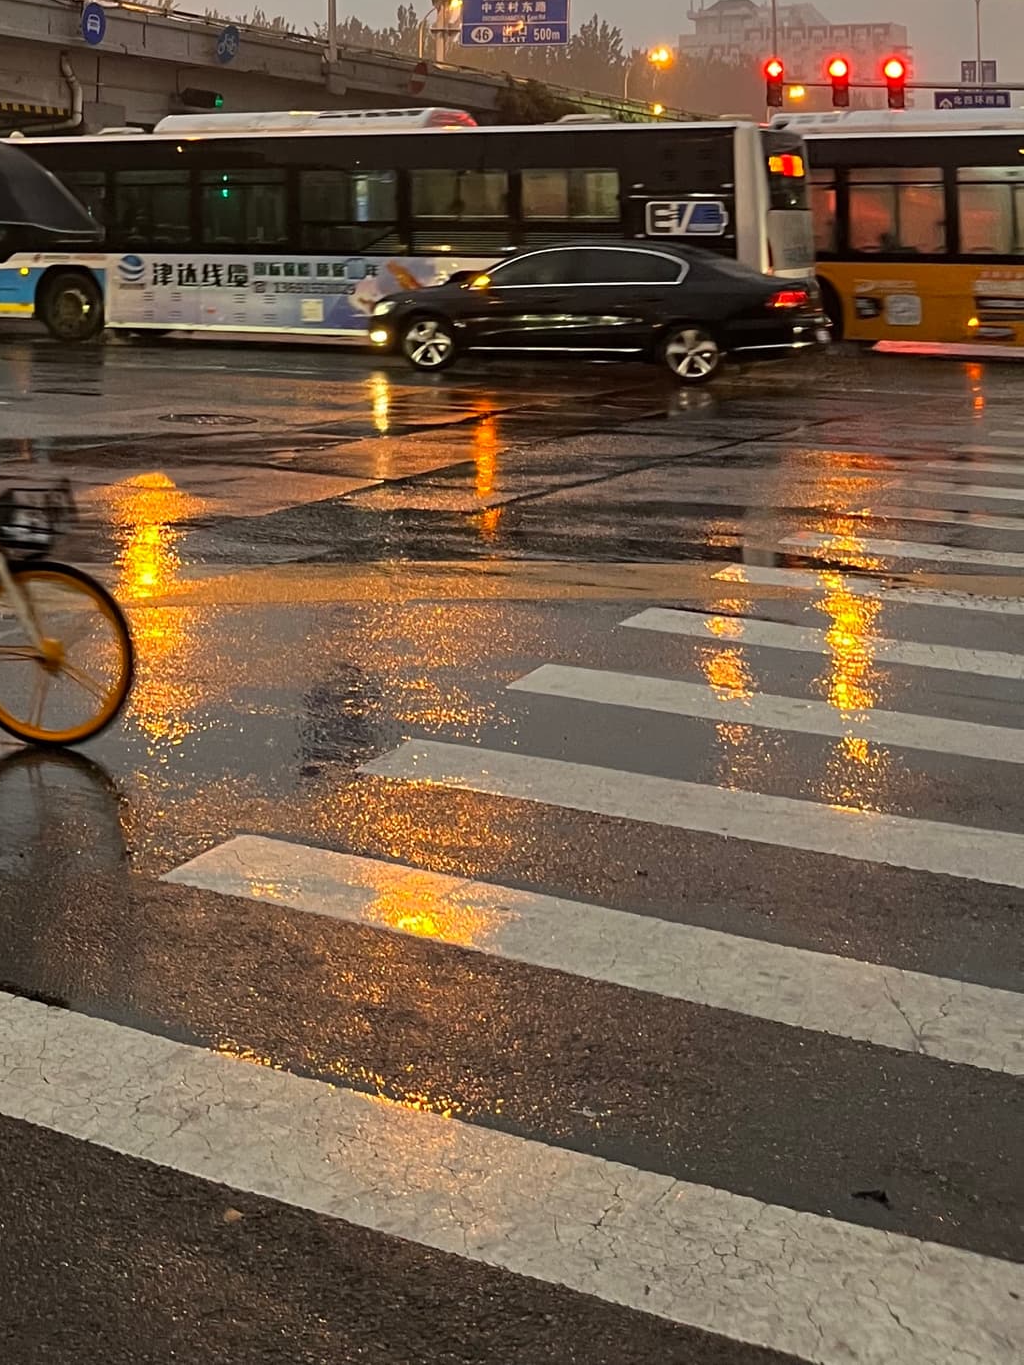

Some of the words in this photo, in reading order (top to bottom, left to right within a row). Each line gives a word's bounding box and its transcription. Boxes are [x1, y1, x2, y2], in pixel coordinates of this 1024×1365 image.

[481, 1, 546, 13] 中关村东路
[475, 29, 490, 41] 46
[534, 28, 561, 41] 500m
